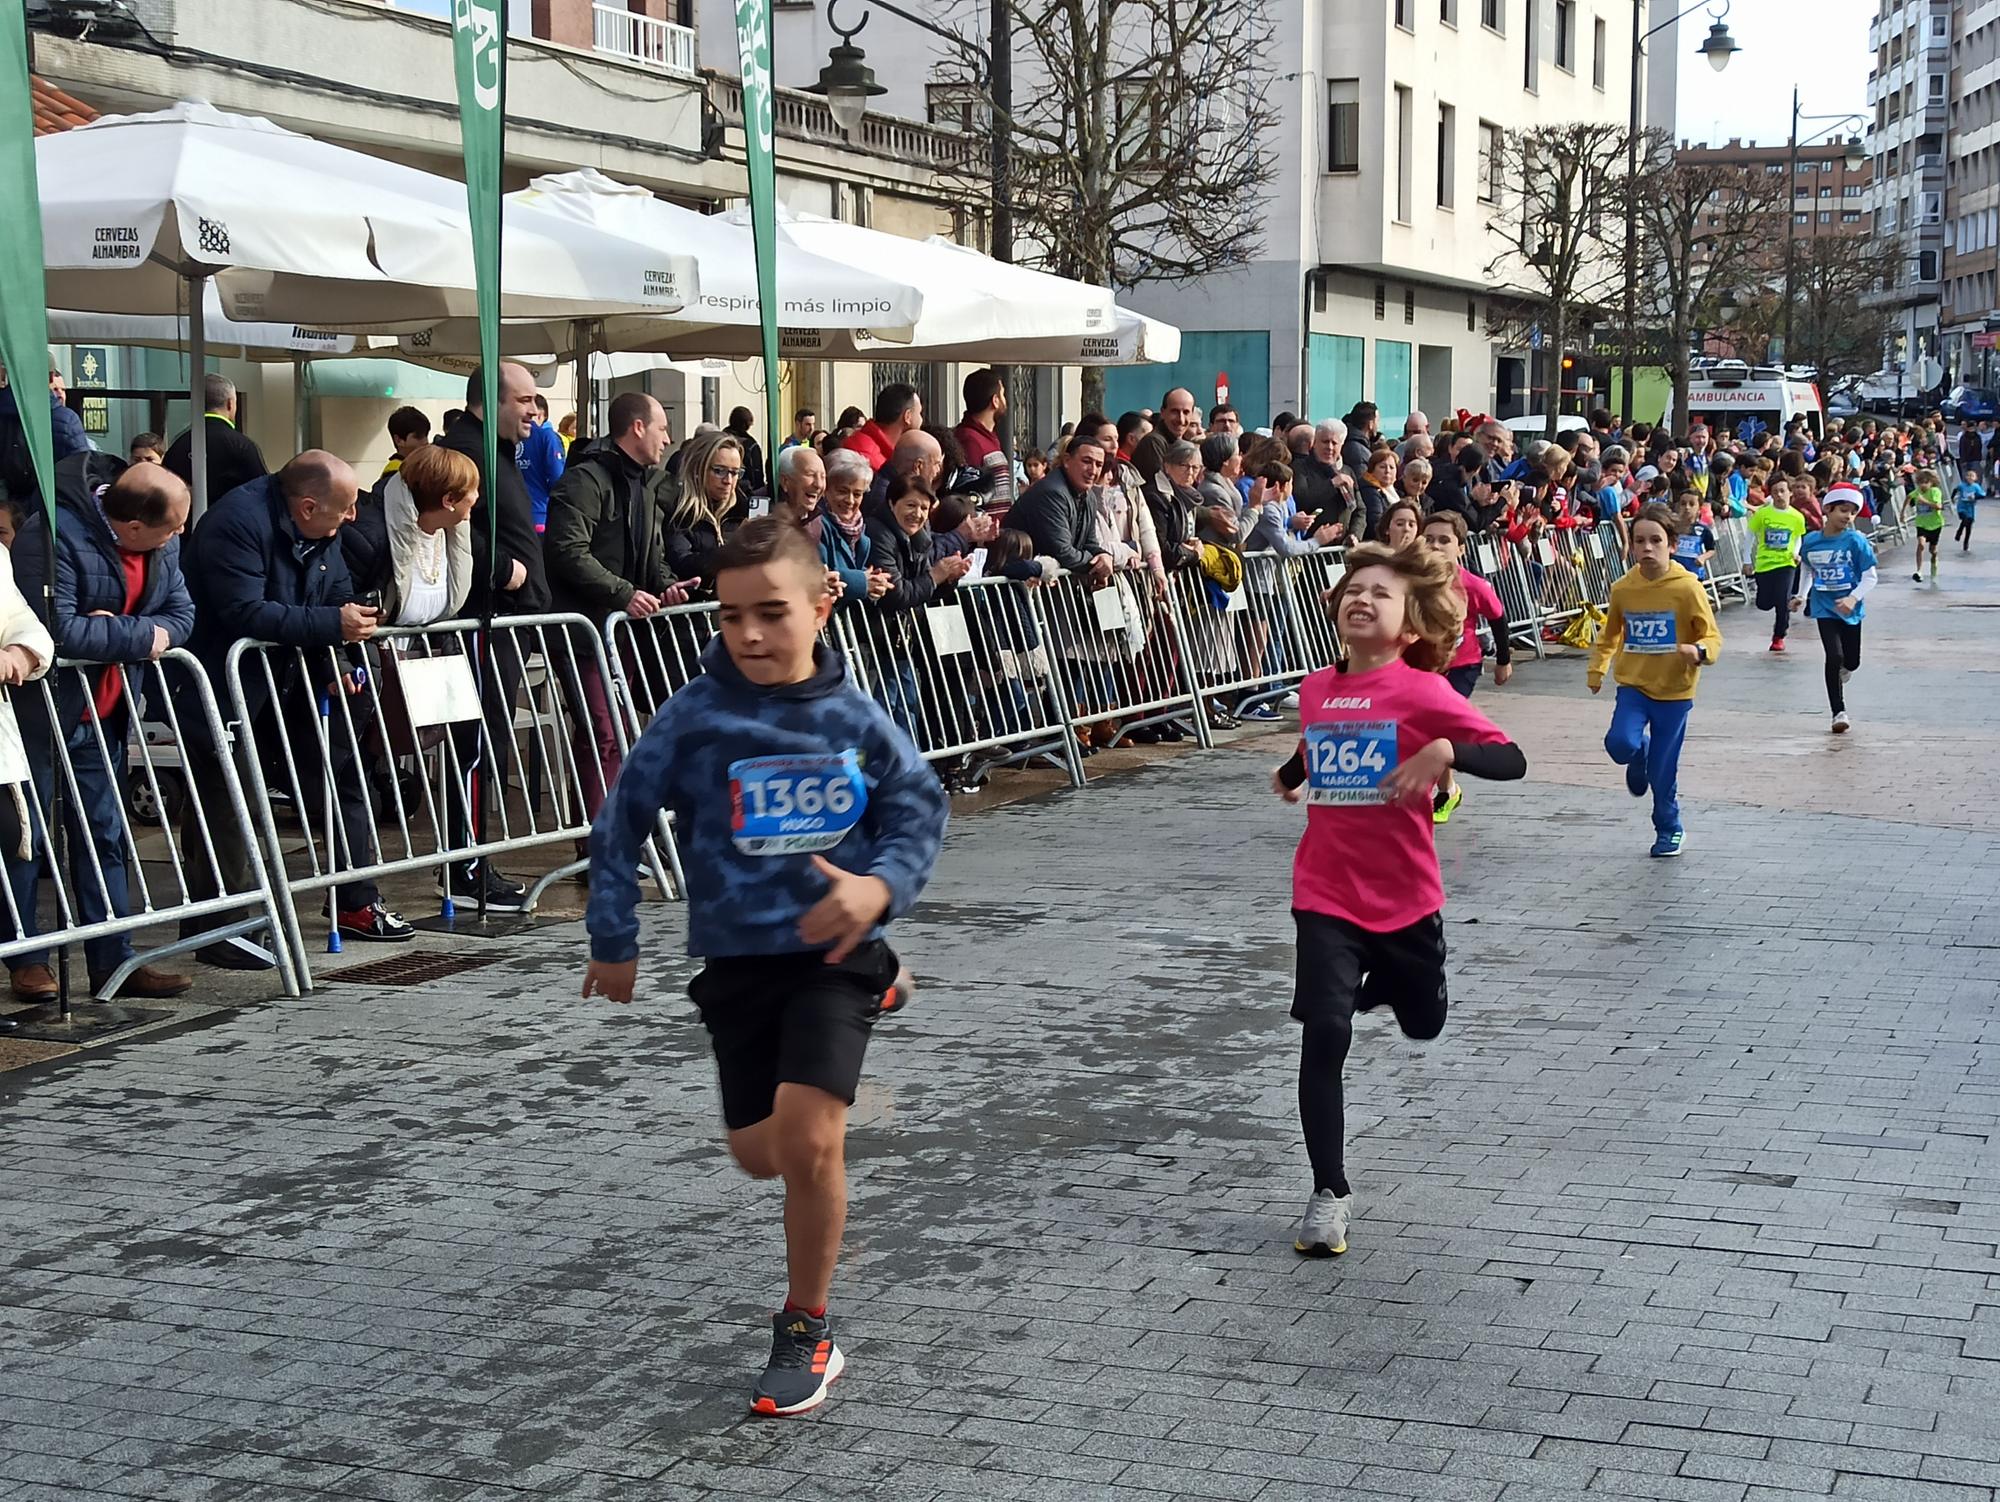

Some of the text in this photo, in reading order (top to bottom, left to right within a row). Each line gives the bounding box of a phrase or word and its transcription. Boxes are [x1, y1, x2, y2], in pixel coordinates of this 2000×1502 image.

[95, 228, 139, 242] CERVEZAS
[92, 245, 141, 259] ALHAMBRA
[644, 270, 676, 284] CERVEZAS
[700, 294, 892, 315] respir más limpio
[782, 337, 822, 347] ALHAMBRA
[1083, 338, 1119, 347] CERVEZAS
[1080, 348, 1119, 357] ALHAMBRA
[1688, 392, 1766, 401] AMBULANCIA
[1816, 568, 1845, 580] 1325
[1627, 620, 1668, 637] 1273
[1321, 697, 1372, 709] LEGEA
[1307, 740, 1386, 773] 1264
[1321, 775, 1369, 786] MARCOS
[744, 777, 855, 819] 1366
